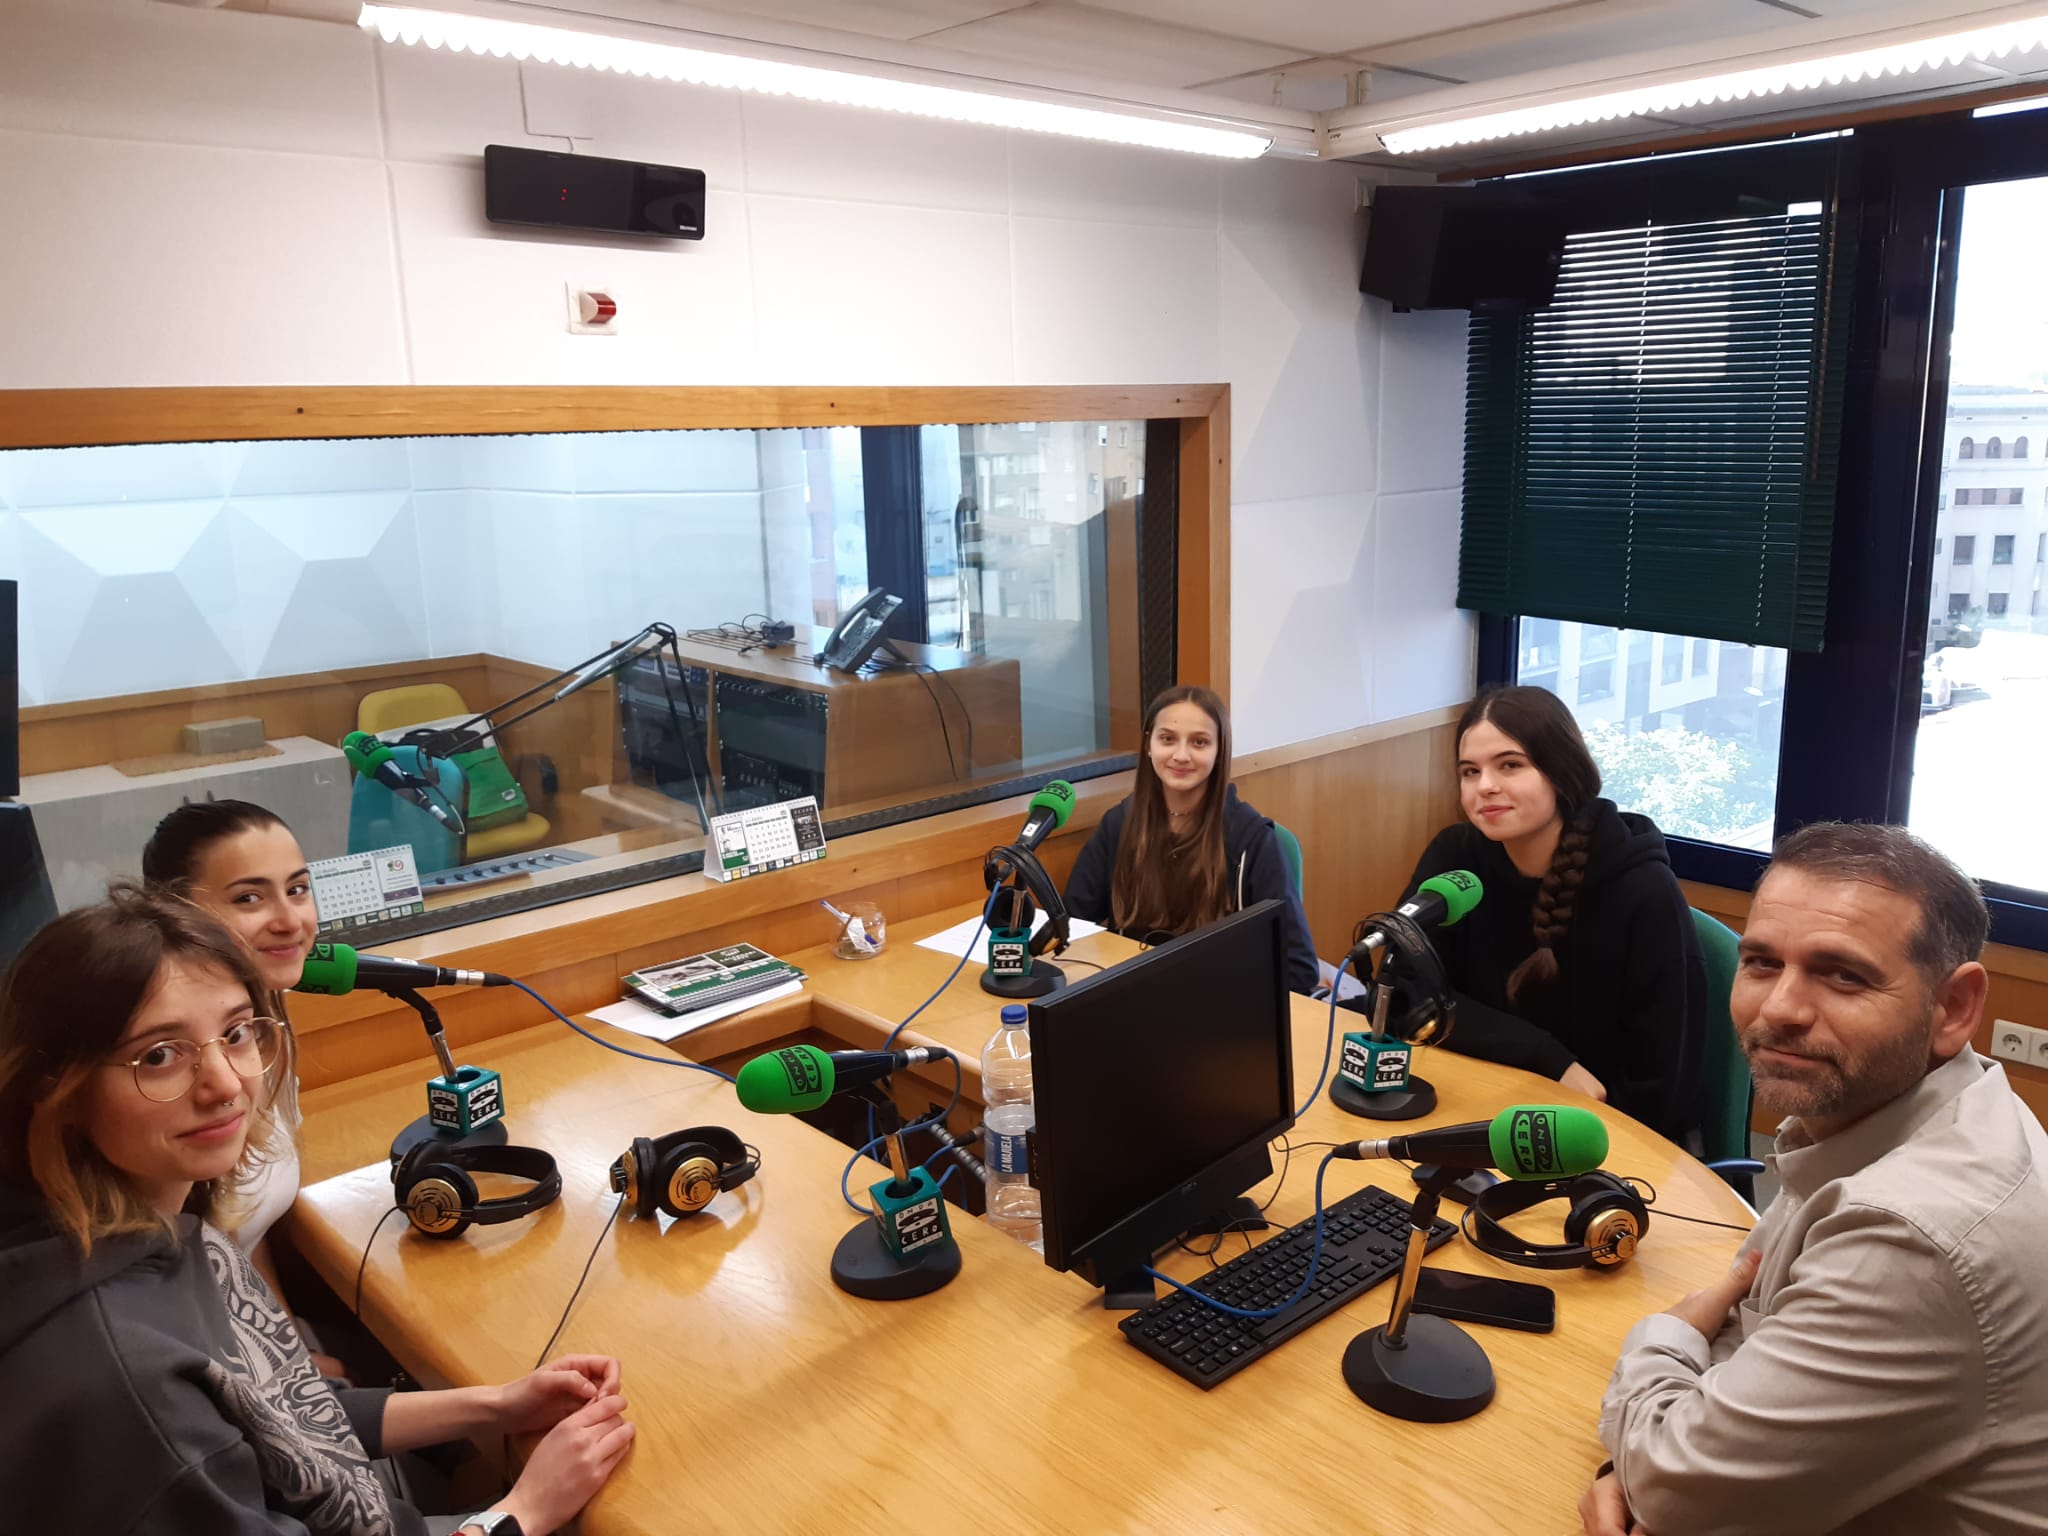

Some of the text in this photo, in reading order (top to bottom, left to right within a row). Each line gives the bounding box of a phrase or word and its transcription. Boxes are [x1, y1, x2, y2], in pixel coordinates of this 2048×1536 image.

[1375, 1072, 1403, 1081] CERO
[470, 1102, 498, 1121] CERO
[1518, 1119, 1533, 1167] CERO
[1536, 1117, 1551, 1168] ONDA
[1001, 1164, 1013, 1173] LA
[898, 1200, 933, 1219] ONDA
[901, 1224, 939, 1245] CERO
